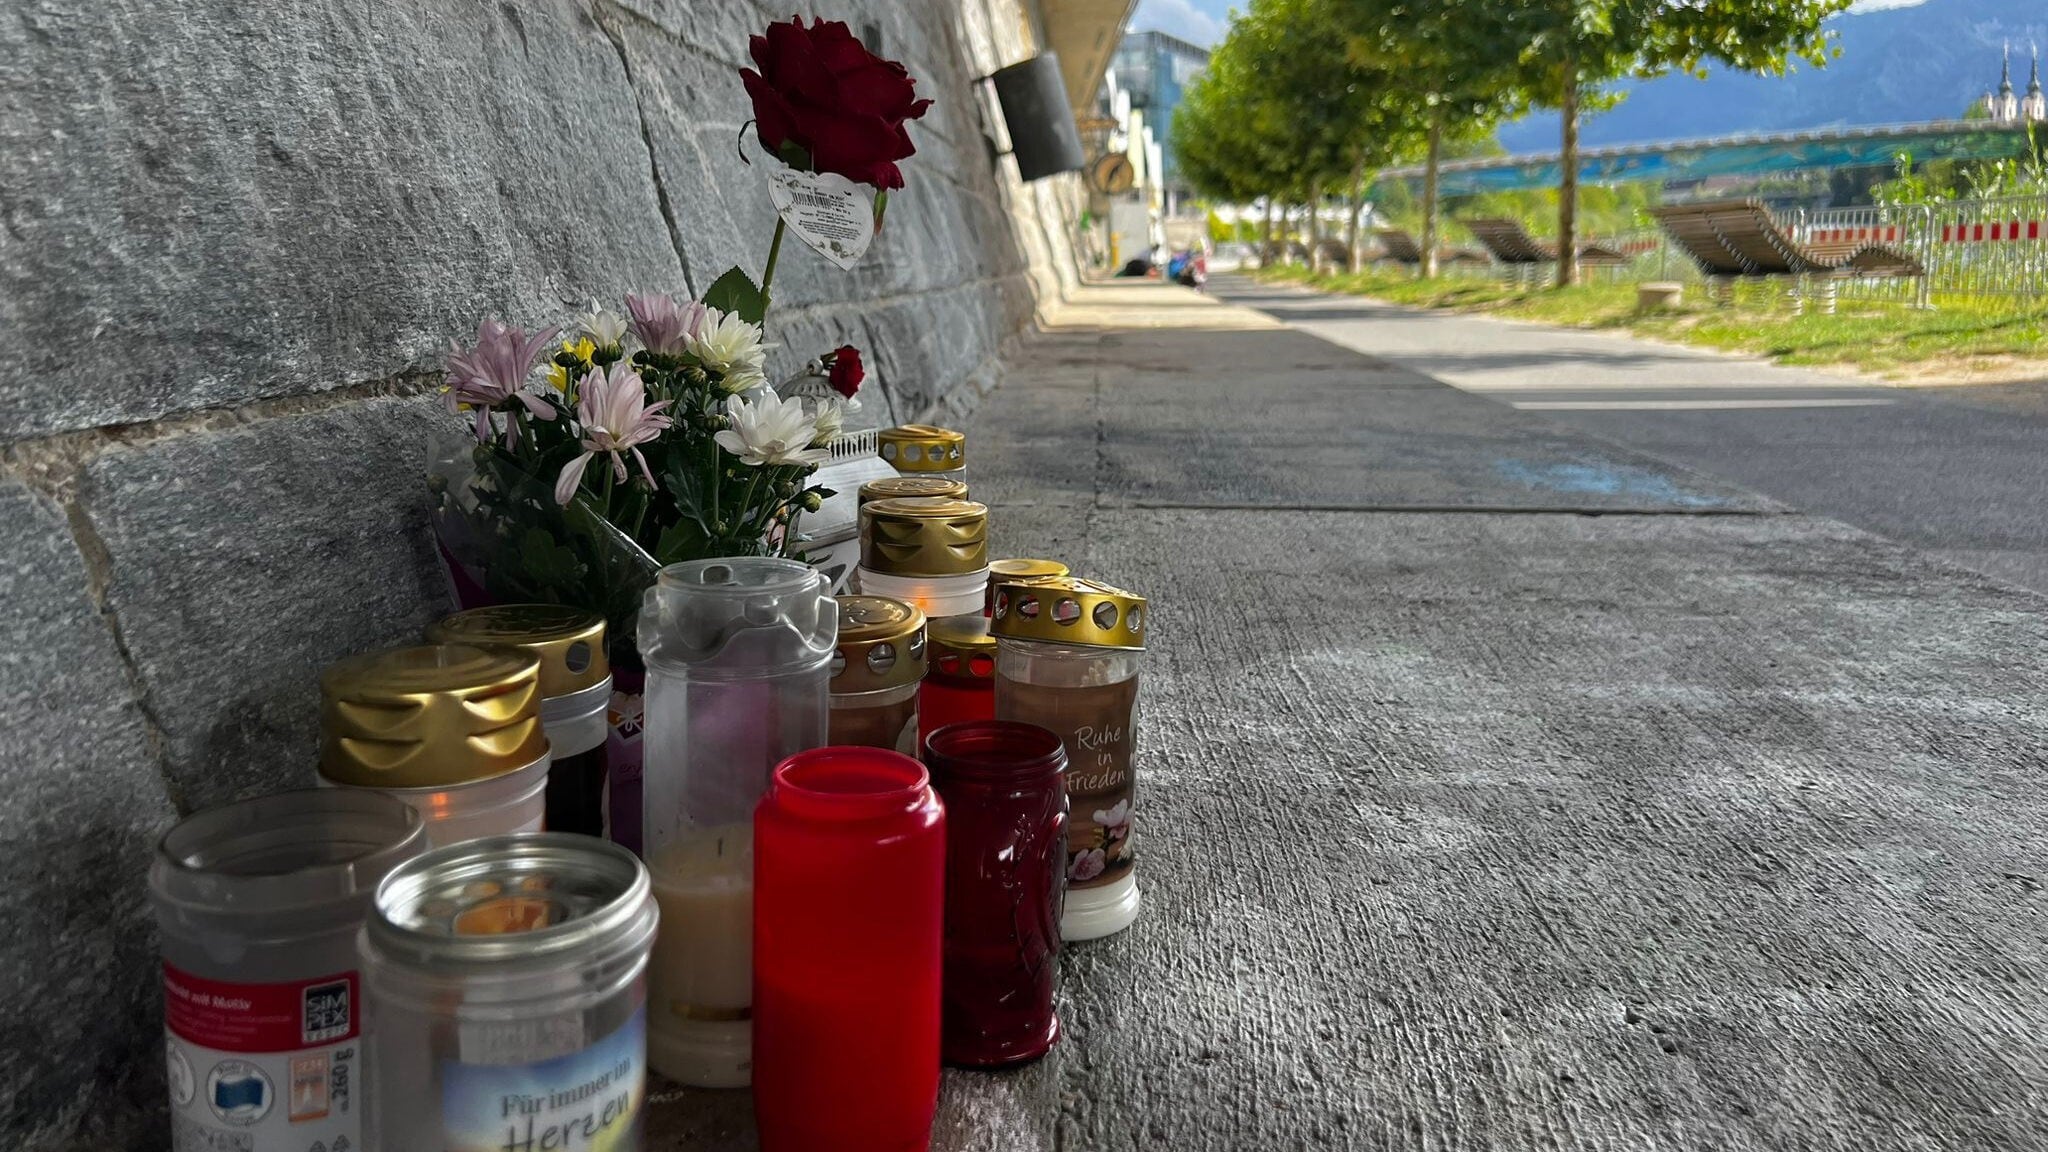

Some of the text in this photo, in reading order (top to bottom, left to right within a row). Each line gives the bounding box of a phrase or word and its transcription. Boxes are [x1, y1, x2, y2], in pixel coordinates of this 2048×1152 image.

[1074, 724, 1121, 750] Ruhe
[1097, 749, 1113, 766] in
[1066, 767, 1126, 793] Frieden
[212, 996, 252, 1012] Motiv
[308, 1008, 347, 1031] PEX
[332, 1064, 349, 1100] 260
[502, 1056, 632, 1118] Für immer im
[501, 1090, 630, 1152] Herzen
